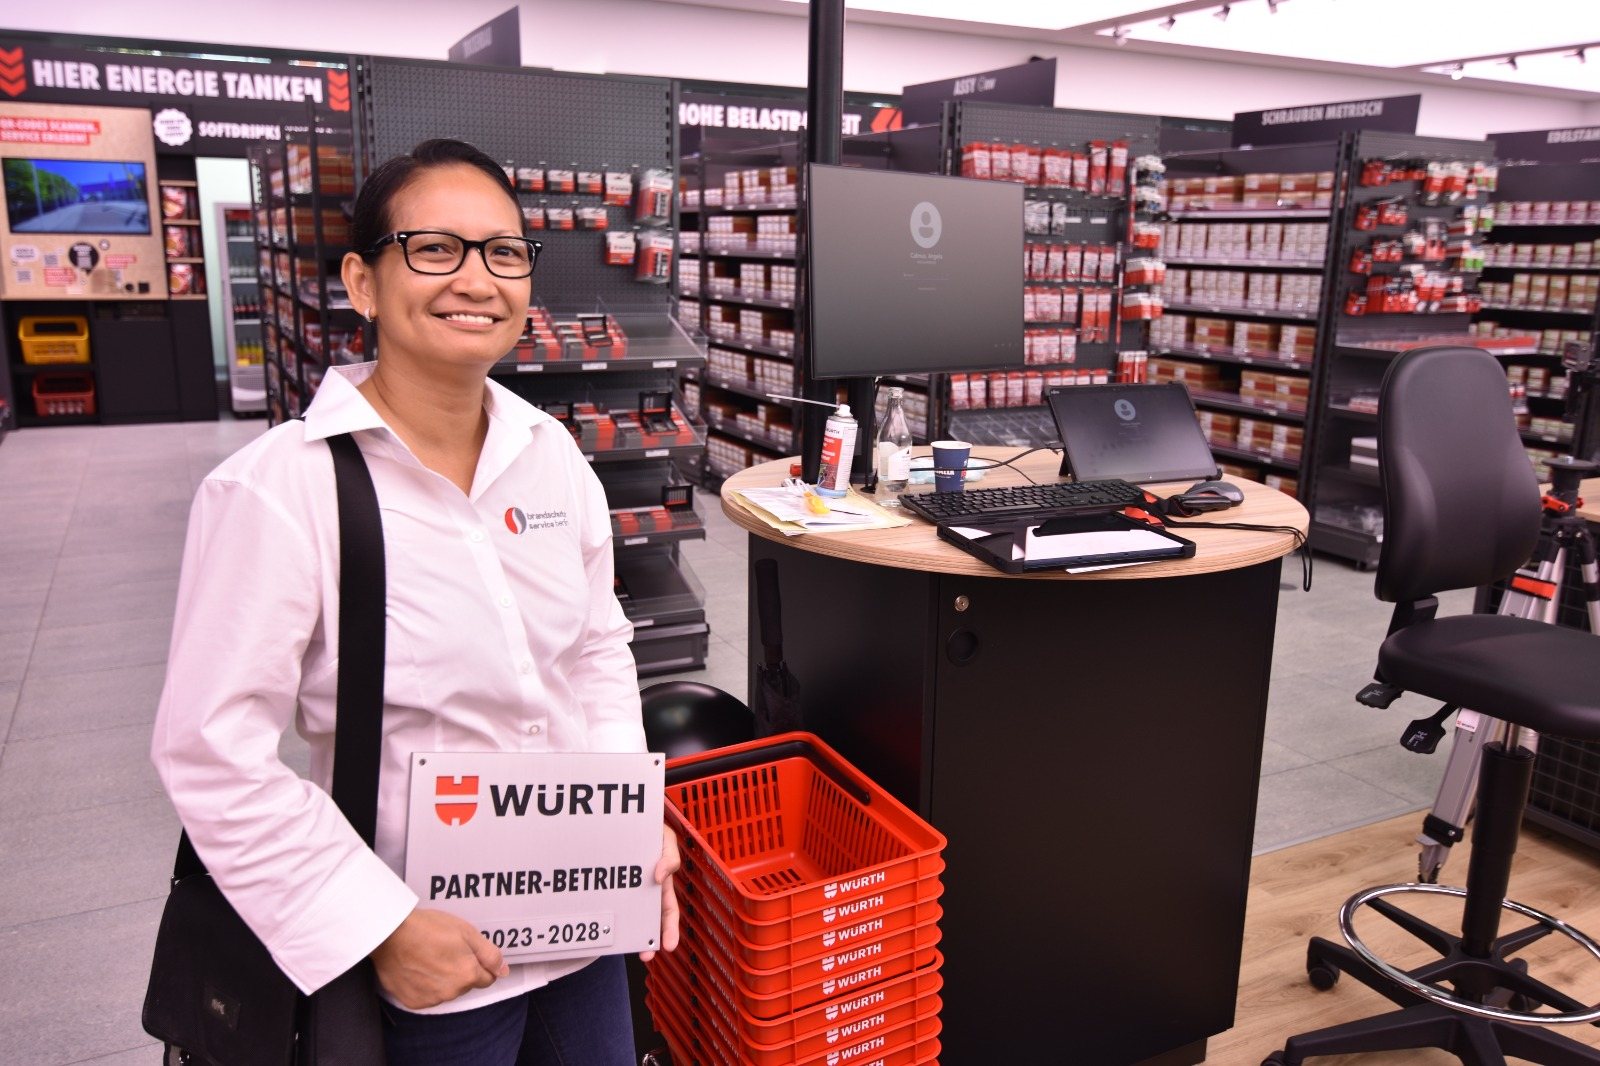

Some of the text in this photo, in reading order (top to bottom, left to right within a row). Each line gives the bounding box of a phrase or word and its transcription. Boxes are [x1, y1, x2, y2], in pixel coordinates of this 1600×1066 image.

[32, 59, 323, 103] HIER ENERGIE TANKEN
[1261, 100, 1383, 126] SCHRAUBEN METRISCH
[490, 783, 645, 817] WÜRTH
[430, 865, 643, 900] PARTNER-BETRIEB
[840, 871, 885, 893] WÜRTH
[838, 895, 884, 917] WÜRTH
[838, 918, 883, 941] WÜRTH
[836, 943, 882, 966] WÜRTH
[837, 966, 882, 988] WÜRTH
[840, 991, 885, 1014] WÜRTH
[841, 1014, 885, 1037] WÜRTH
[841, 1036, 885, 1060] WÜRTH
